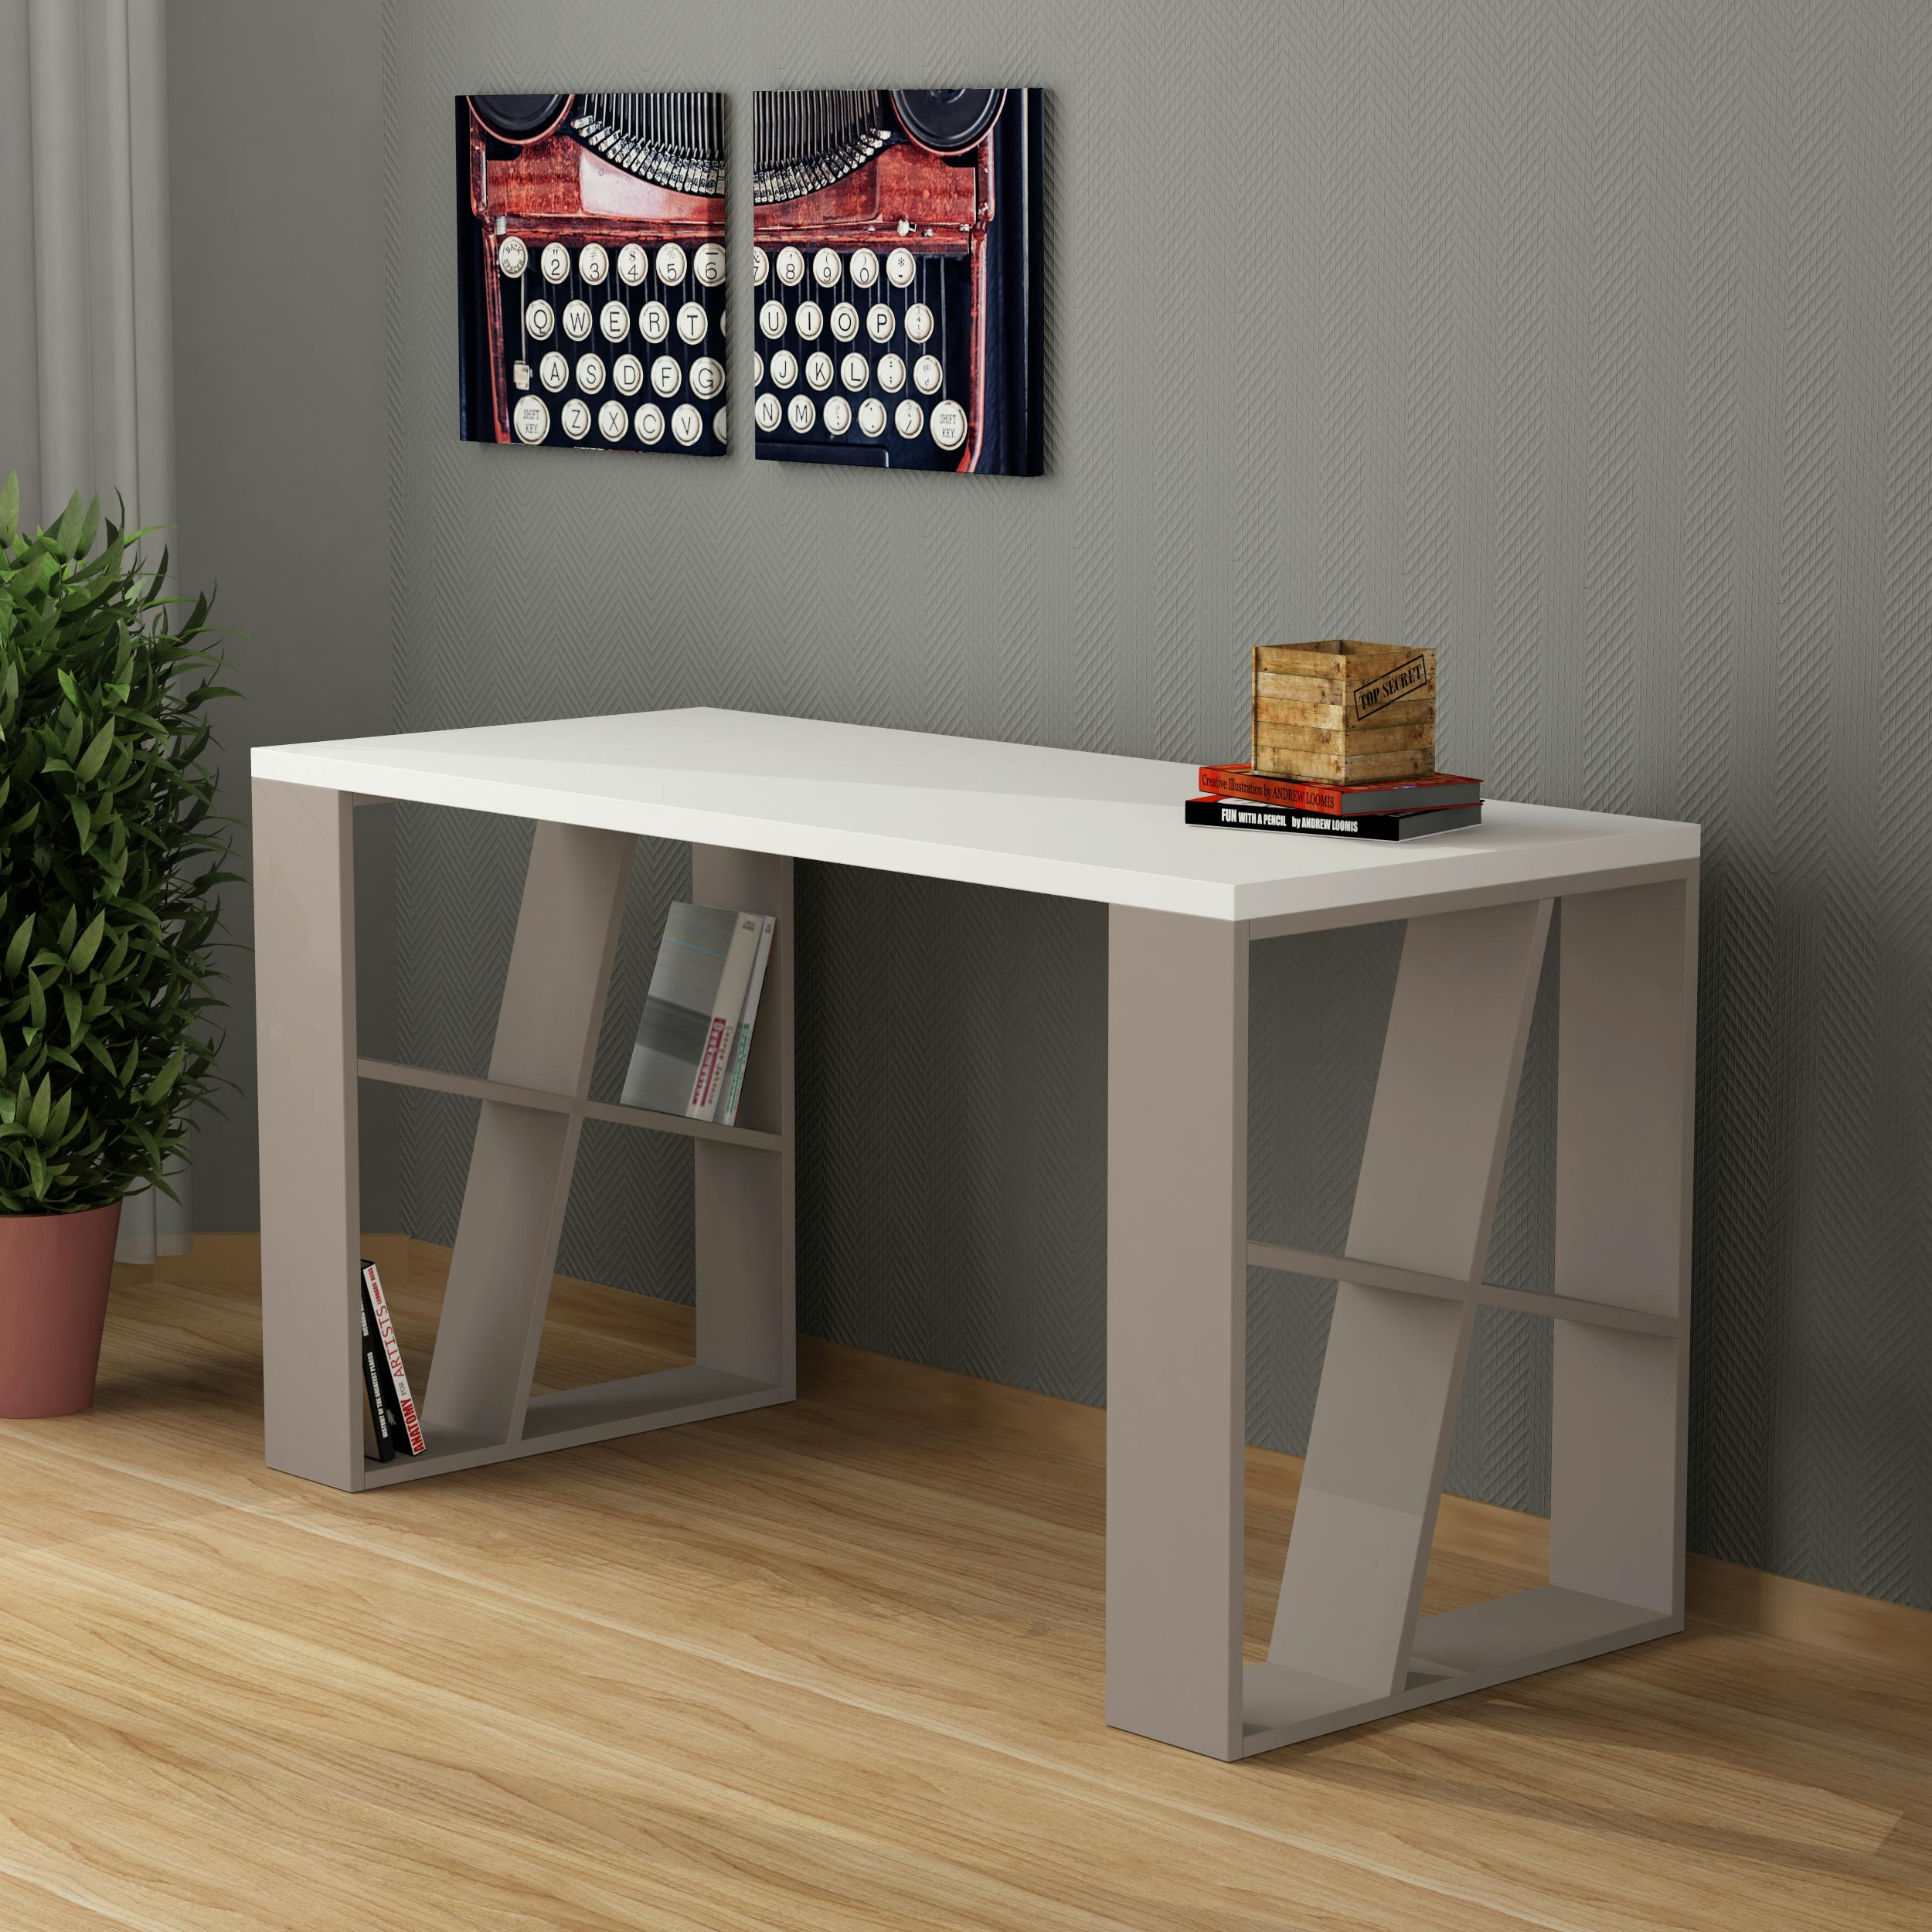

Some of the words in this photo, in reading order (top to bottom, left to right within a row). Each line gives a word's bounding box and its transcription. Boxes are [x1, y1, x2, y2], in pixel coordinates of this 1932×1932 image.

[506, 243, 522, 254] BACK
[502, 259, 523, 272] SPACER
[551, 259, 560, 275] 2
[590, 263, 600, 279] 3
[628, 264, 638, 281] 4
[667, 264, 677, 281] 5
[706, 262, 717, 280] 6
[786, 264, 795, 280] 8
[823, 267, 832, 282] 9
[534, 309, 547, 334] Q
[570, 312, 586, 332] W
[610, 311, 621, 332] E
[650, 312, 660, 332] R
[687, 315, 698, 335] T
[768, 311, 779, 332] U
[838, 313, 852, 332] O
[877, 314, 887, 333] P
[550, 362, 560, 382] A
[587, 365, 596, 384] S
[624, 366, 636, 384] D
[662, 367, 672, 387] F
[699, 368, 713, 389] G
[779, 361, 787, 378] J
[815, 362, 826, 381] K
[851, 362, 861, 381] L
[572, 410, 580, 428] Z
[609, 412, 618, 431] X
[763, 403, 773, 421] N
[796, 404, 808, 423] M
[940, 414, 956, 424] SHIFT
[643, 414, 656, 434] C
[682, 417, 691, 435] V
[1359, 689, 1379, 710] TOP
[1382, 663, 1422, 698] SECRET
[1202, 774, 1226, 790] Creative
[1228, 776, 1262, 796] Illustration
[1264, 785, 1271, 800] by
[1272, 788, 1304, 804] ANDREW
[1306, 791, 1334, 808] LOOMIS
[1221, 808, 1236, 822] FUN
[1238, 811, 1256, 825] WITH
[1257, 814, 1263, 825] A
[1263, 814, 1287, 827] PENCIL
[1291, 817, 1301, 829] by
[1301, 818, 1331, 831] ANDREW
[1332, 820, 1358, 832] LOOMIS
[376, 1305, 405, 1377] ARTISTS
[367, 1352, 376, 1372] PLACES
[371, 1372, 380, 1397] GREATEST
[398, 1381, 407, 1396] FOR
[379, 1415, 388, 1438] HISTORY
[400, 1398, 425, 1454] ANATOMY
